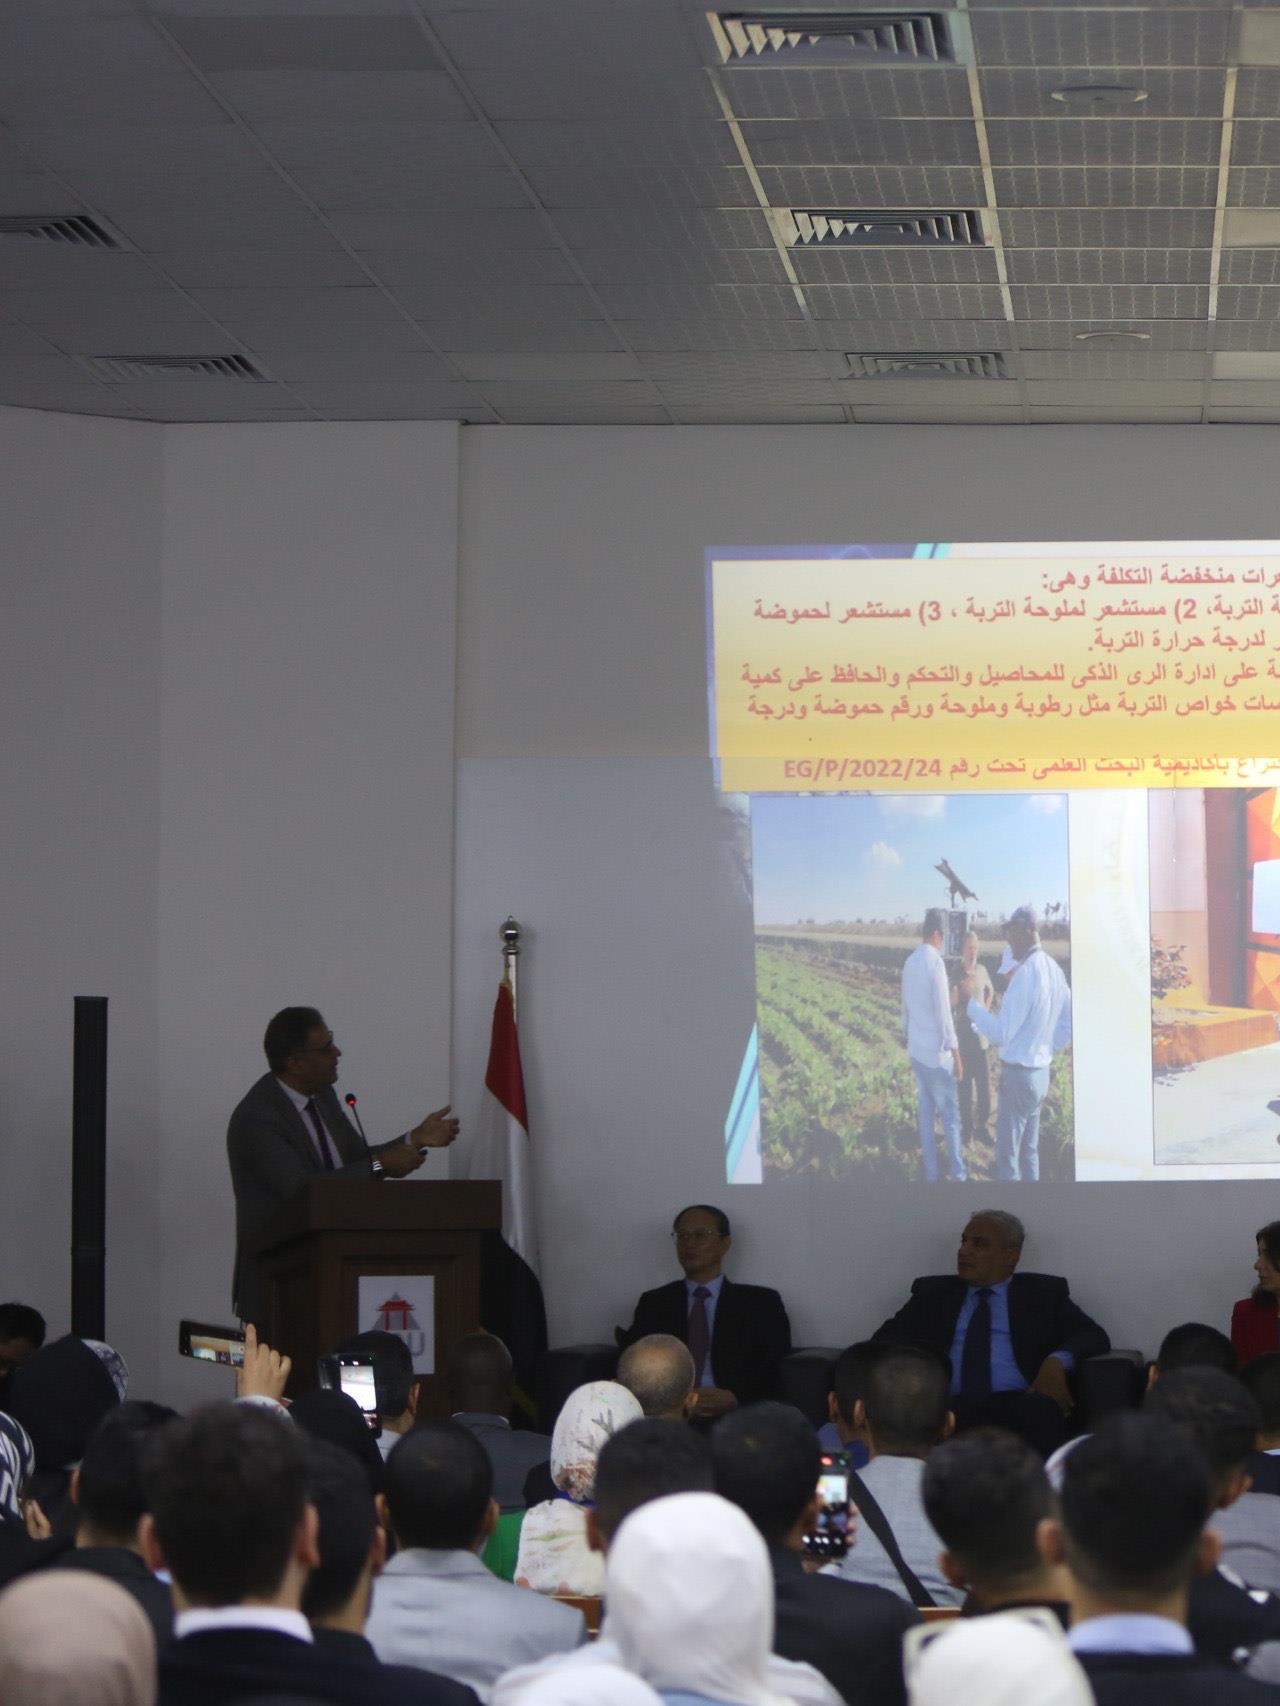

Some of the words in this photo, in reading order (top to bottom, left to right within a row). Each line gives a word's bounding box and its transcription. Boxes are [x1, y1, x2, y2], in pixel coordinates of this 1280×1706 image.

[1097, 565, 1153, 586] التكلفة
[1161, 563, 1236, 586] منخفضة
[754, 599, 832, 626] لحموضة
[839, 602, 913, 625] مستشعر
[1024, 596, 1087, 623] لملوحة
[1094, 599, 1168, 623] مستشعر
[1153, 630, 1206, 654] حرارة
[1213, 625, 1267, 653] لدرجة
[742, 664, 783, 690] كمية
[789, 667, 824, 694] على
[907, 664, 974, 691] والتحكم
[980, 663, 1066, 688] للمحاصيل
[1072, 663, 1119, 691] الذكى
[1128, 662, 1168, 686] الرى
[1175, 663, 1217, 686] ادارة
[1224, 663, 1259, 689] على
[749, 694, 809, 721] ودرجة
[815, 695, 885, 721] حموضة
[891, 694, 935, 722] ورقم
[941, 693, 1010, 719] وملوحة
[1015, 691, 1073, 719] رطوبة
[1080, 694, 1112, 718] مثل
[1118, 692, 1168, 718] التربة
[1176, 695, 1238, 718] خواص
[785, 759, 943, 783] EG/P/2022/24
